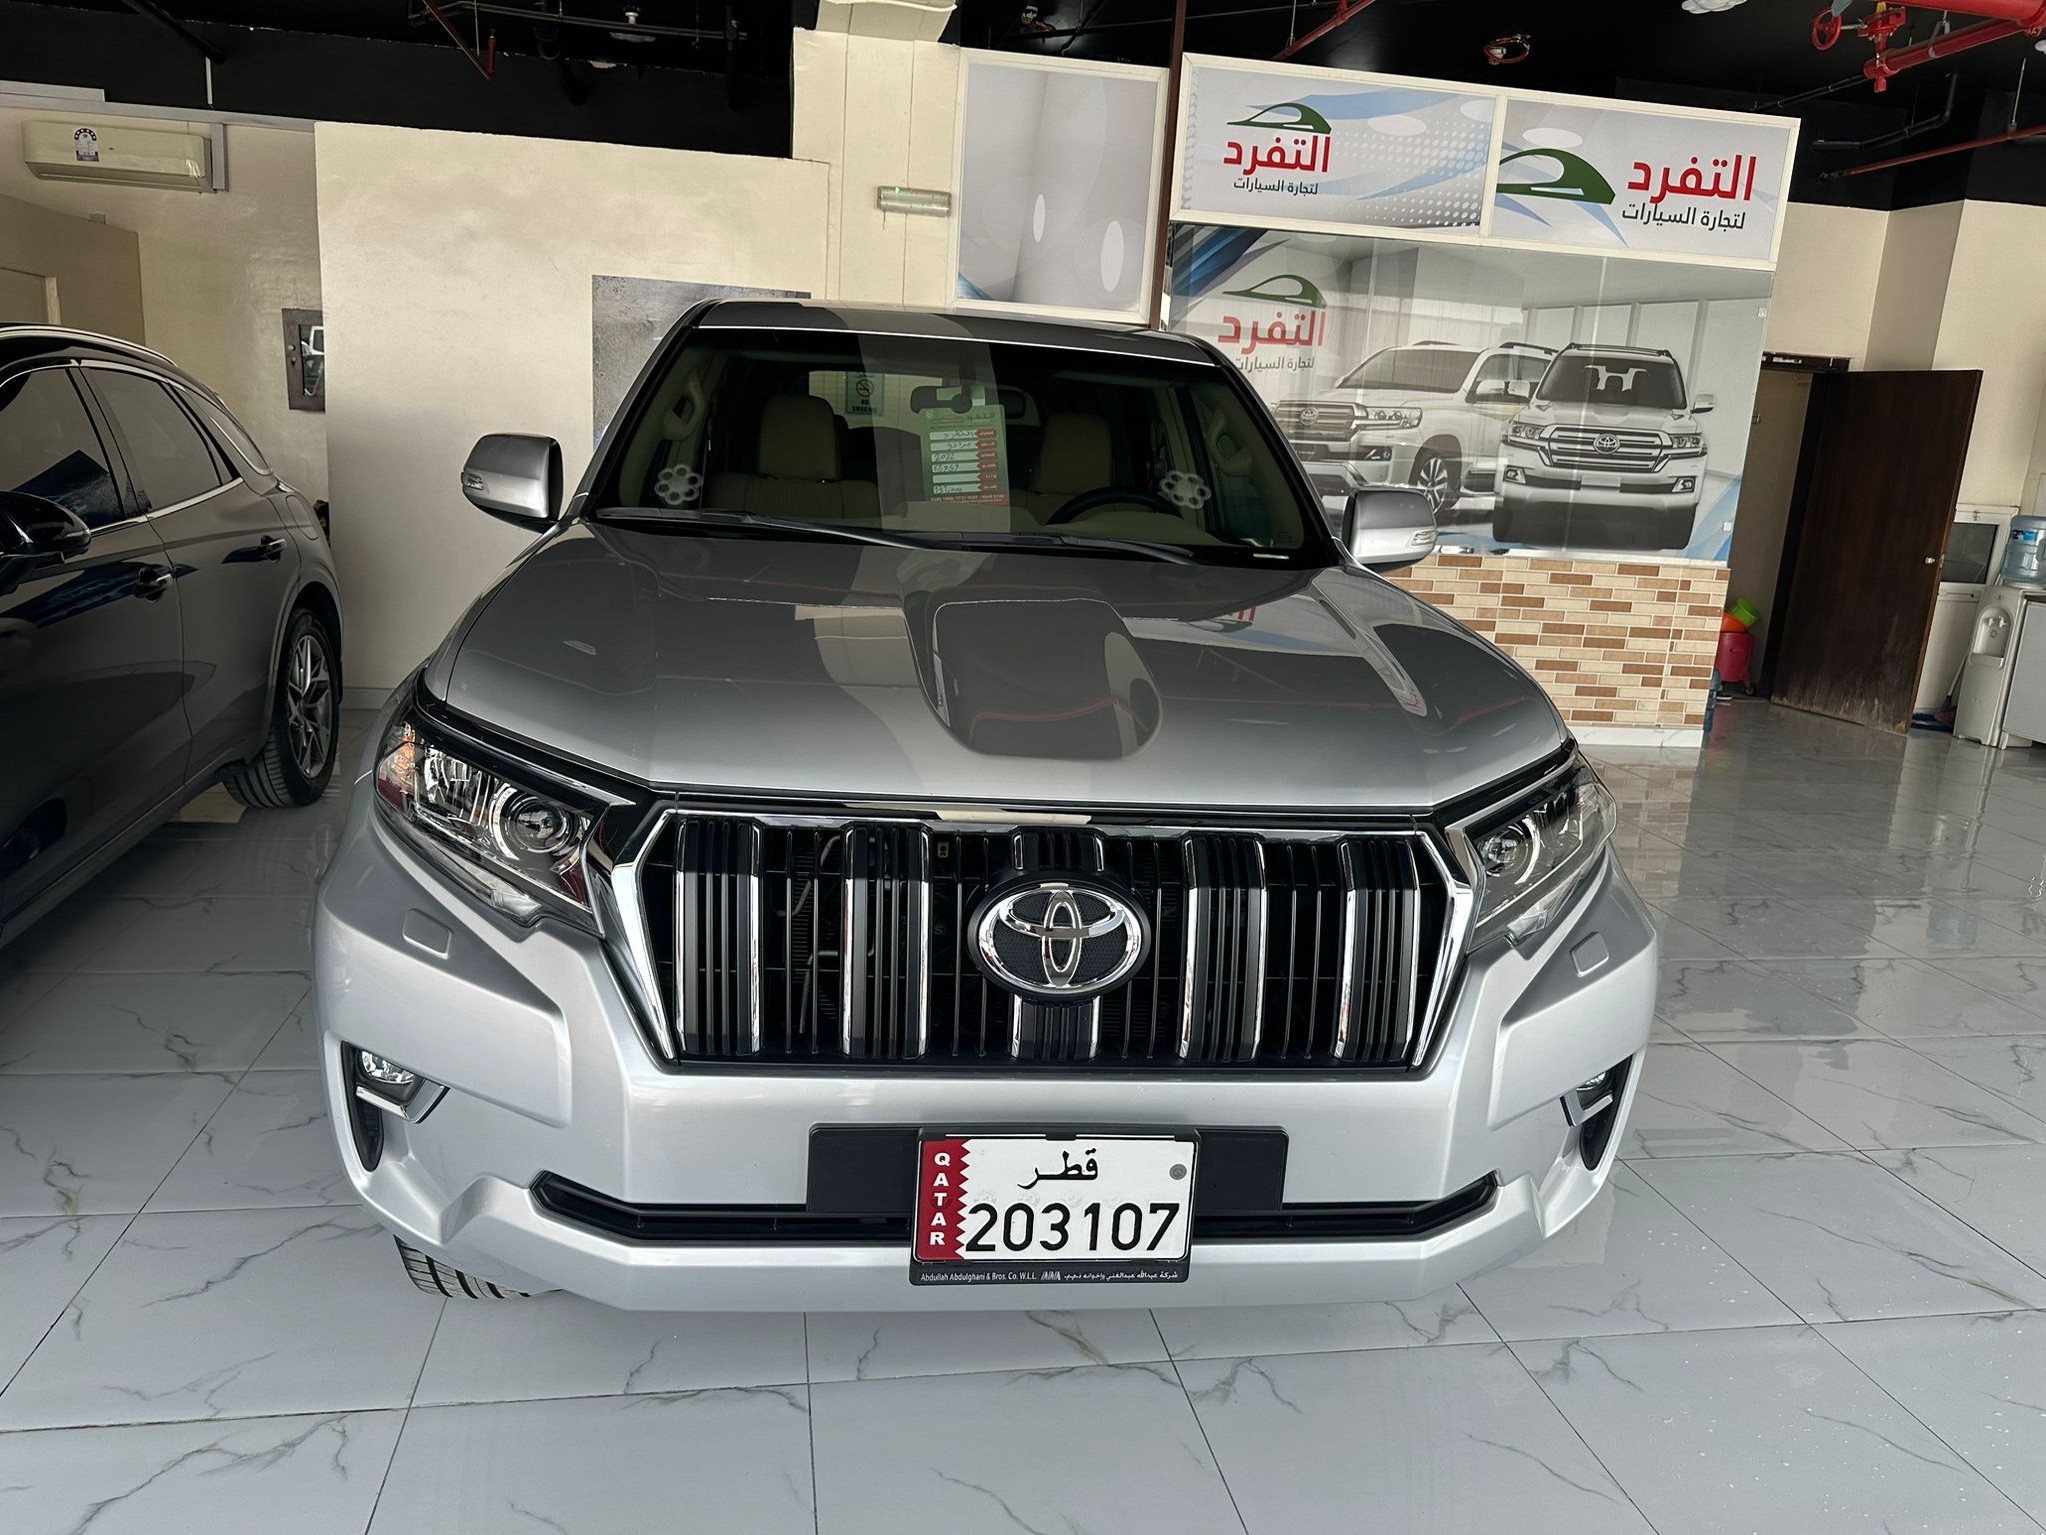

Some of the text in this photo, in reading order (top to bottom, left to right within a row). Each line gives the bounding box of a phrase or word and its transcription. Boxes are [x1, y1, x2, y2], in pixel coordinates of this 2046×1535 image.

[1223, 135, 1331, 175] التفرد
[1234, 177, 1318, 196] لتجارة السيارات
[1627, 154, 1757, 204] التفرد
[1622, 202, 1746, 232] لتجارة السيارات
[1218, 310, 1326, 355] التفرد
[1235, 356, 1315, 373] لتجارة السيارات
[1017, 1147, 1099, 1190] قطر
[929, 1152, 951, 1246] QATAR
[965, 1202, 1181, 1252] 203107
[920, 1272, 948, 1281] Abdullah
[949, 1272, 986, 1283] Abdulghani
[986, 1272, 991, 1281] &
[1160, 1271, 1179, 1280] شركة
